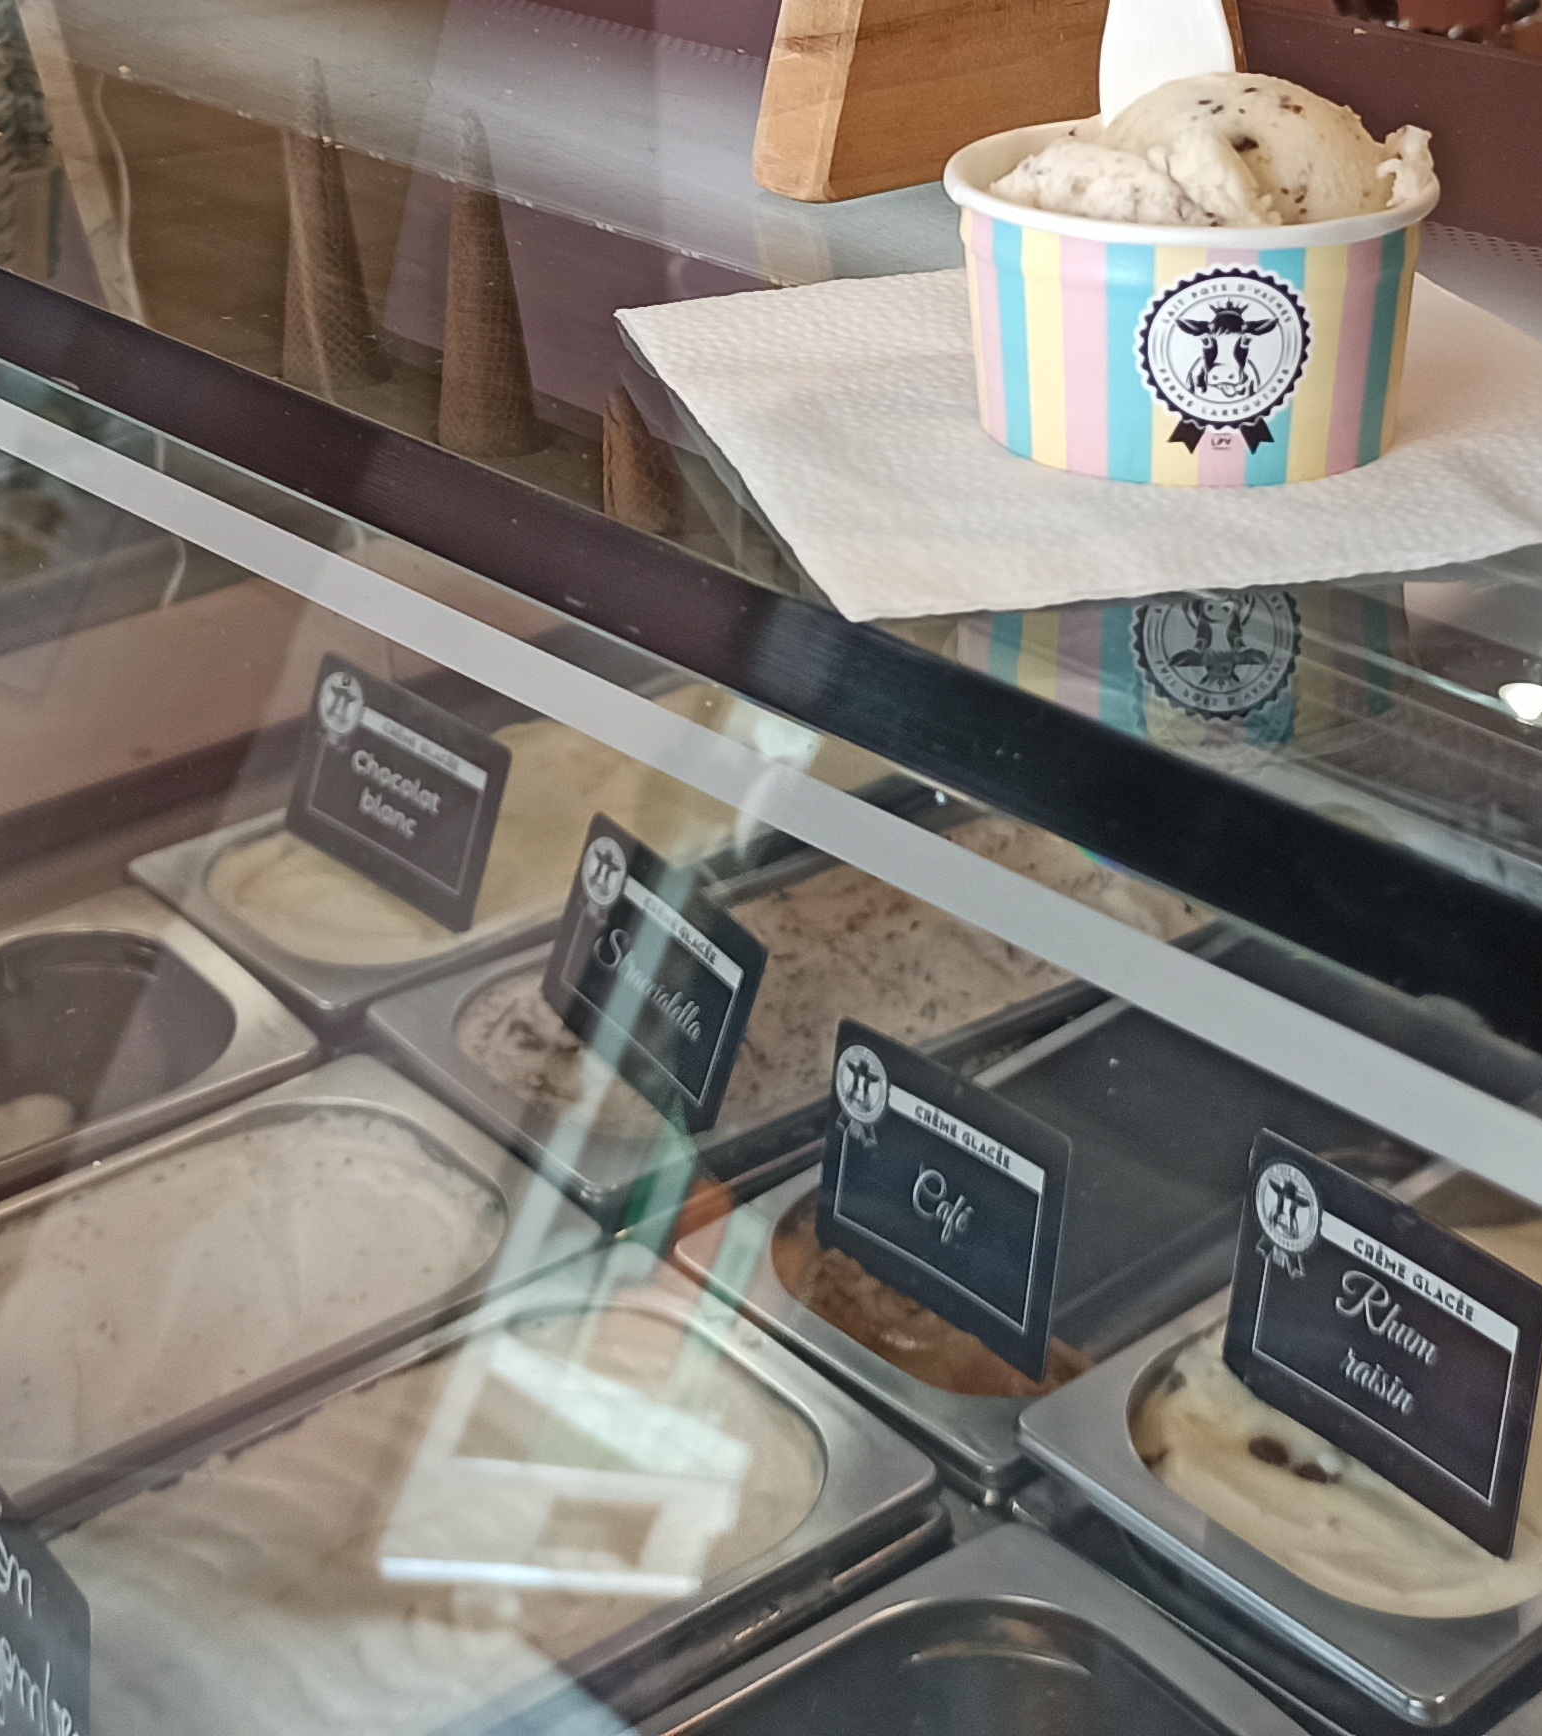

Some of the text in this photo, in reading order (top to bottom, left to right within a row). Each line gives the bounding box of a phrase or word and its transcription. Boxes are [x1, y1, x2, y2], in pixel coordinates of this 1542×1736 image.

[351, 749, 441, 814] Chocolat
[1335, 1269, 1439, 1365] Rhum
[1353, 1236, 1476, 1322] CRÈME GLACÉE
[1340, 1347, 1415, 1415] raisin
